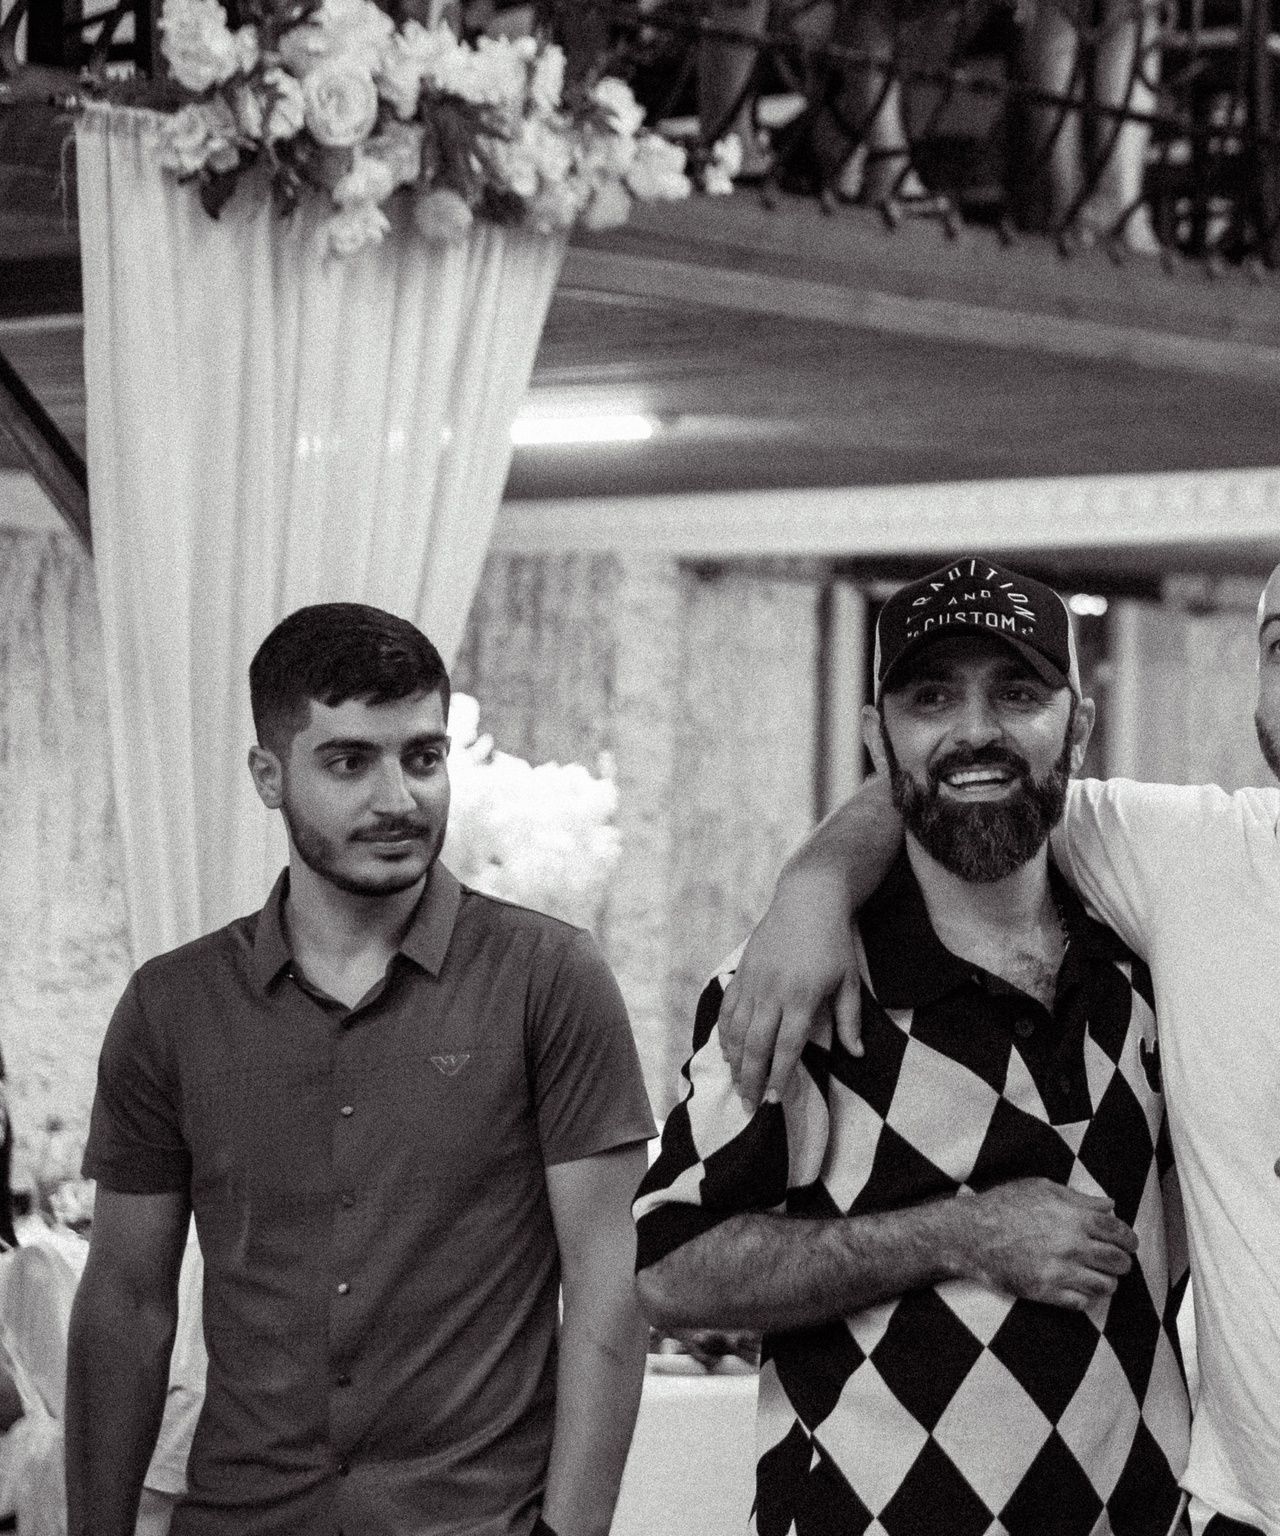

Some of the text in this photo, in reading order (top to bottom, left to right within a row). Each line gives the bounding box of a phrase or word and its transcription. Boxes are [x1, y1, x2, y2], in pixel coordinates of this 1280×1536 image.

[906, 559, 1036, 624] TRADITION
[948, 590, 991, 606] AND
[924, 612, 1015, 632] CUSTOM
